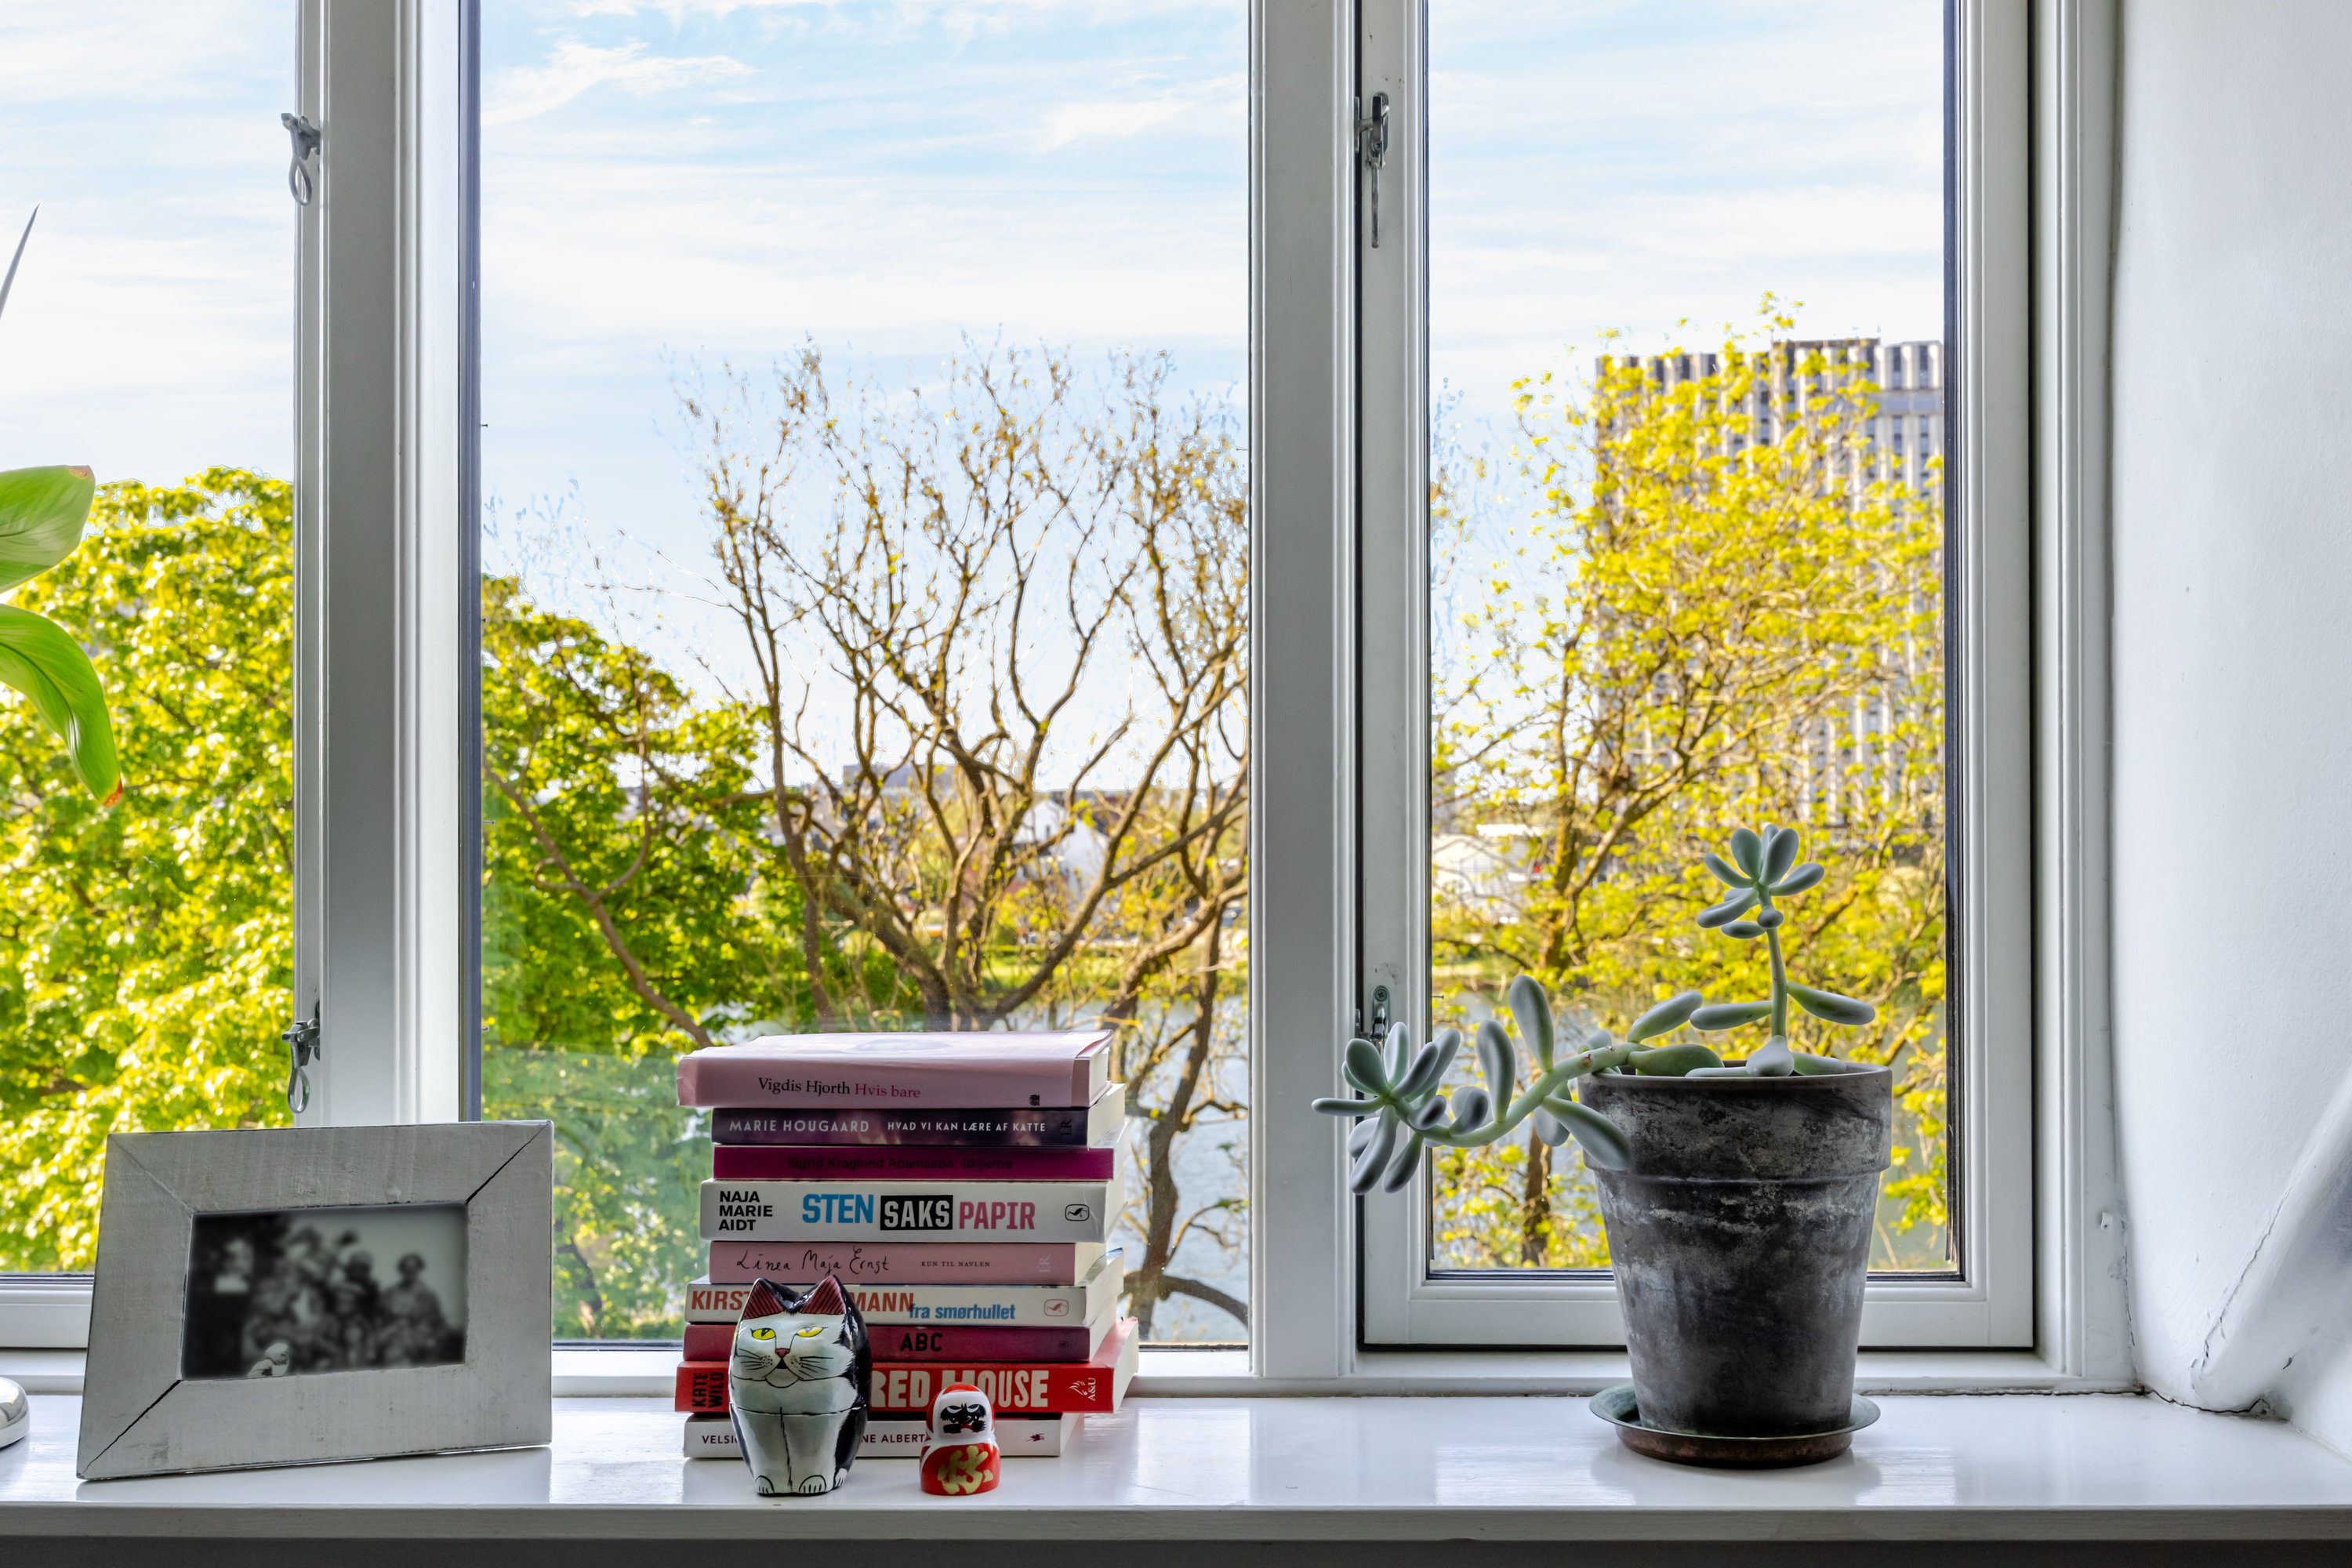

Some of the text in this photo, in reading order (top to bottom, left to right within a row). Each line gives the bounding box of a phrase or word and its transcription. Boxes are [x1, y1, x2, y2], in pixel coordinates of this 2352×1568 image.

[758, 1077, 921, 1098] Vigdis Hjorth Hvis bare
[729, 1120, 869, 1132] MARIE HOUGAARD
[887, 1122, 1046, 1132] HVAD VI KAN LÆRE AF KATTE
[787, 1156, 824, 1170] Sigrid
[827, 1157, 884, 1170] Kraglund
[961, 1157, 1012, 1171] Skyerne
[719, 1190, 760, 1203] NAJA
[719, 1205, 773, 1217] MARIE
[802, 1194, 1036, 1229] STEN SAKS PAPIR
[718, 1219, 757, 1231] AIDT
[737, 1246, 889, 1276] Linea Maja Ernst
[909, 1303, 1016, 1319] fra smørhullet
[901, 1332, 943, 1352] ABC
[691, 1372, 708, 1407] KATE
[708, 1372, 724, 1408] WILD
[870, 1370, 931, 1407] RED
[1087, 1377, 1097, 1402] A&U
